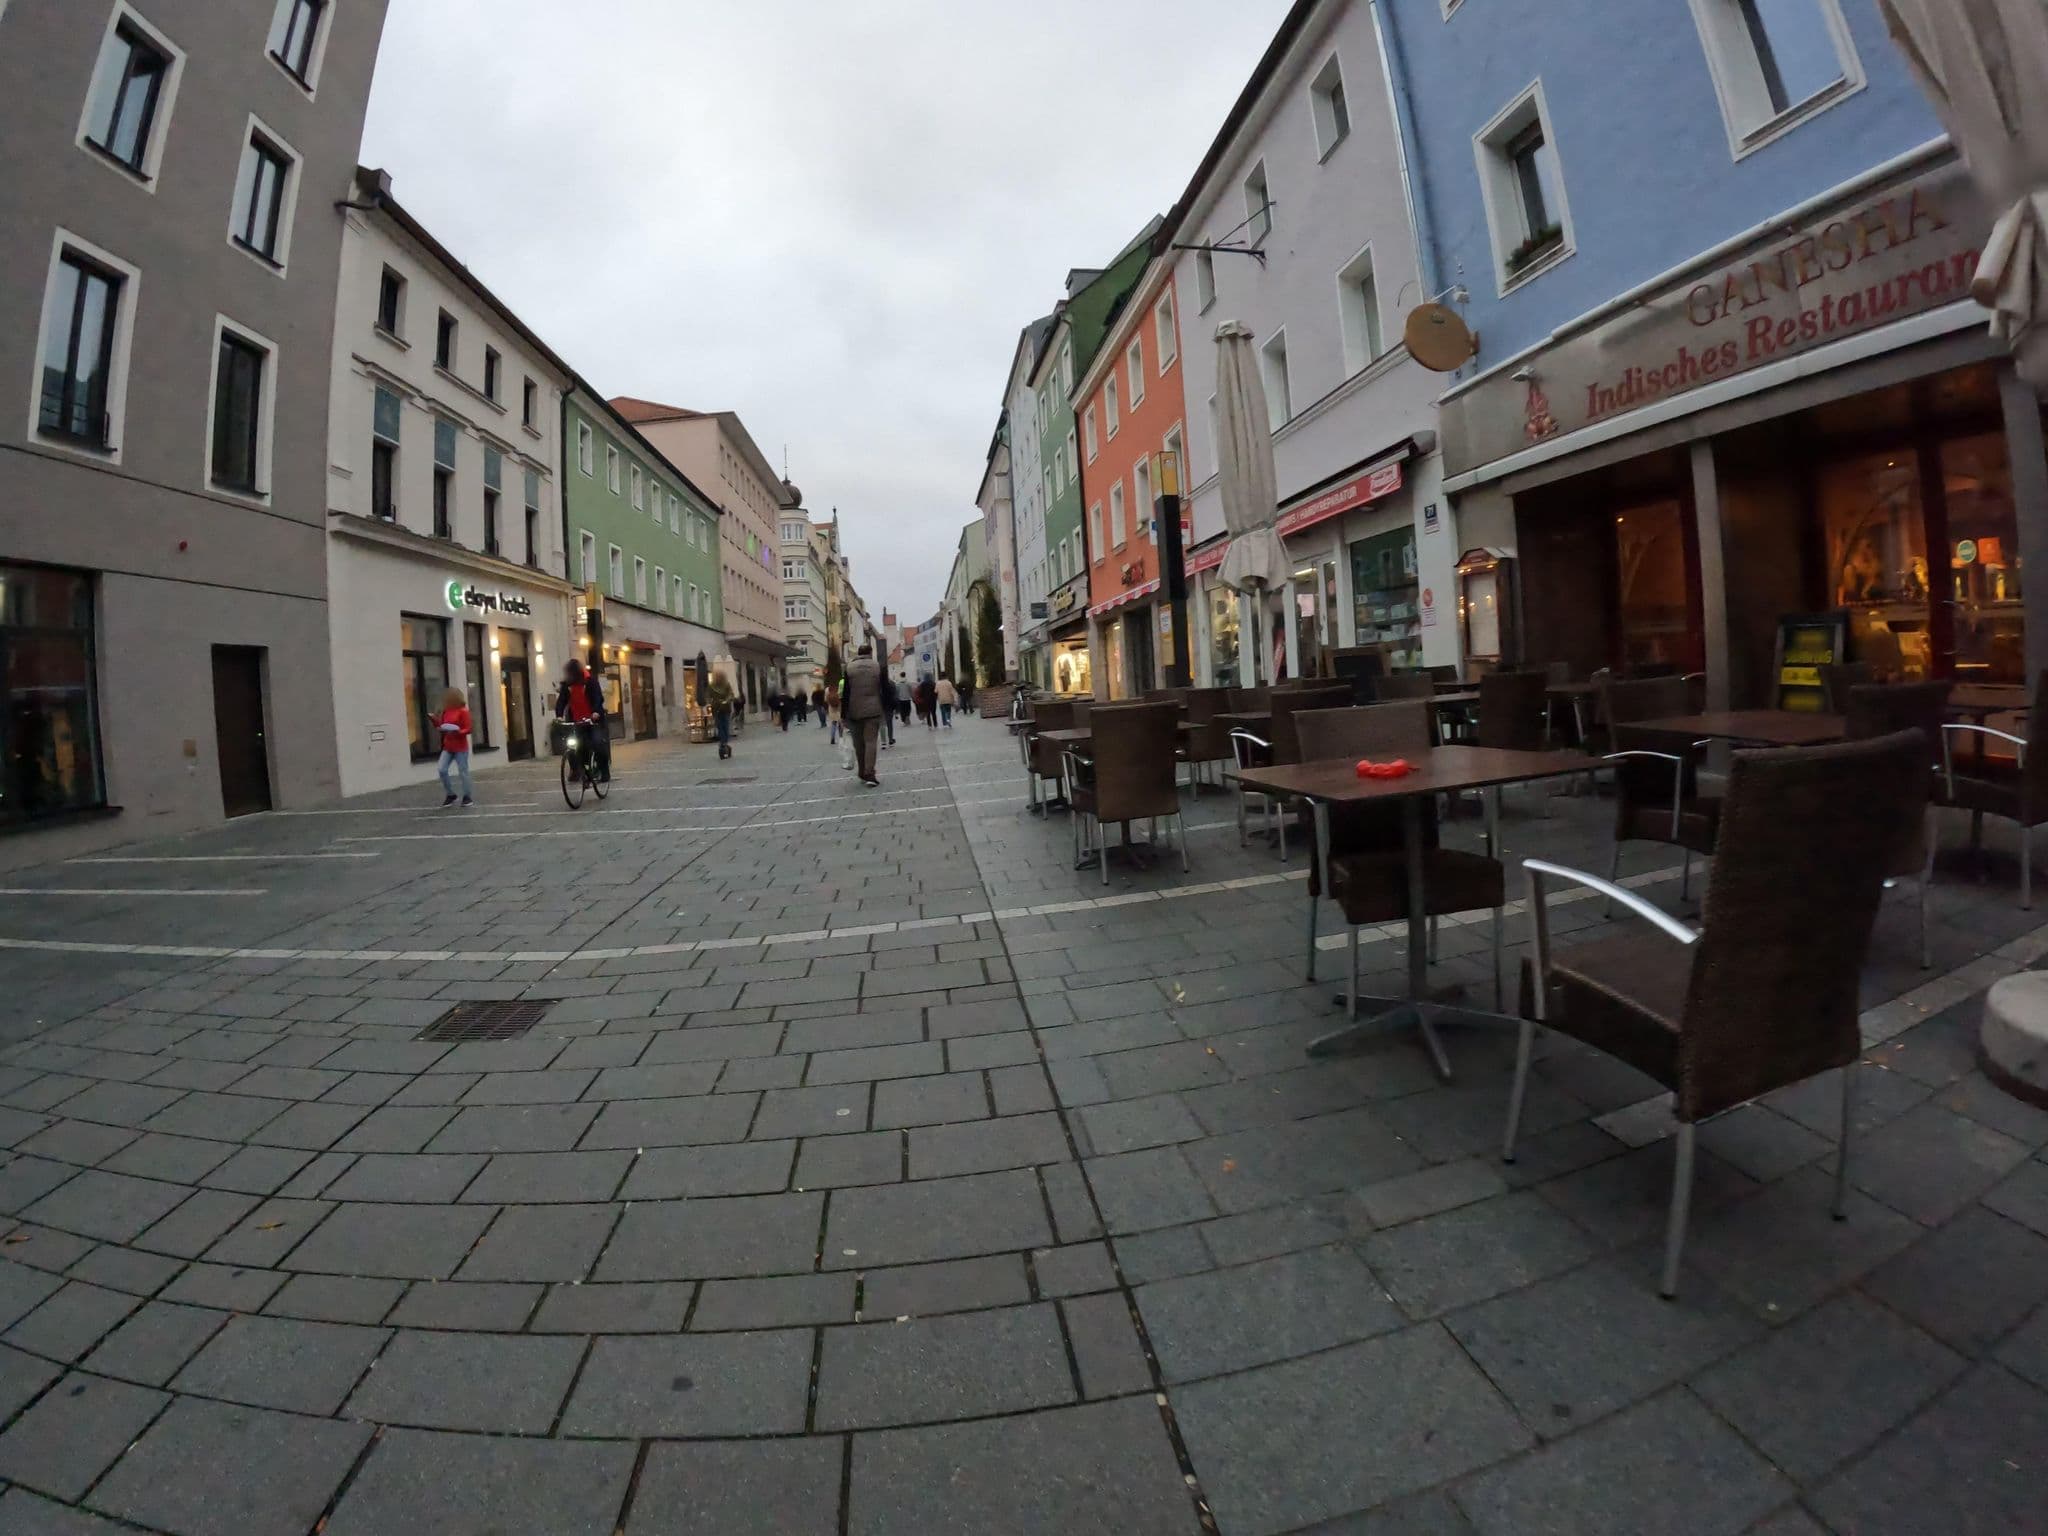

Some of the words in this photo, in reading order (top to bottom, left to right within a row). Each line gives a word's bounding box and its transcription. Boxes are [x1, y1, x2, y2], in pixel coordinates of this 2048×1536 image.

[1586, 339, 1738, 417] Indisches
[1745, 247, 1981, 362] Restauran
[1687, 188, 1950, 327] GANESHA
